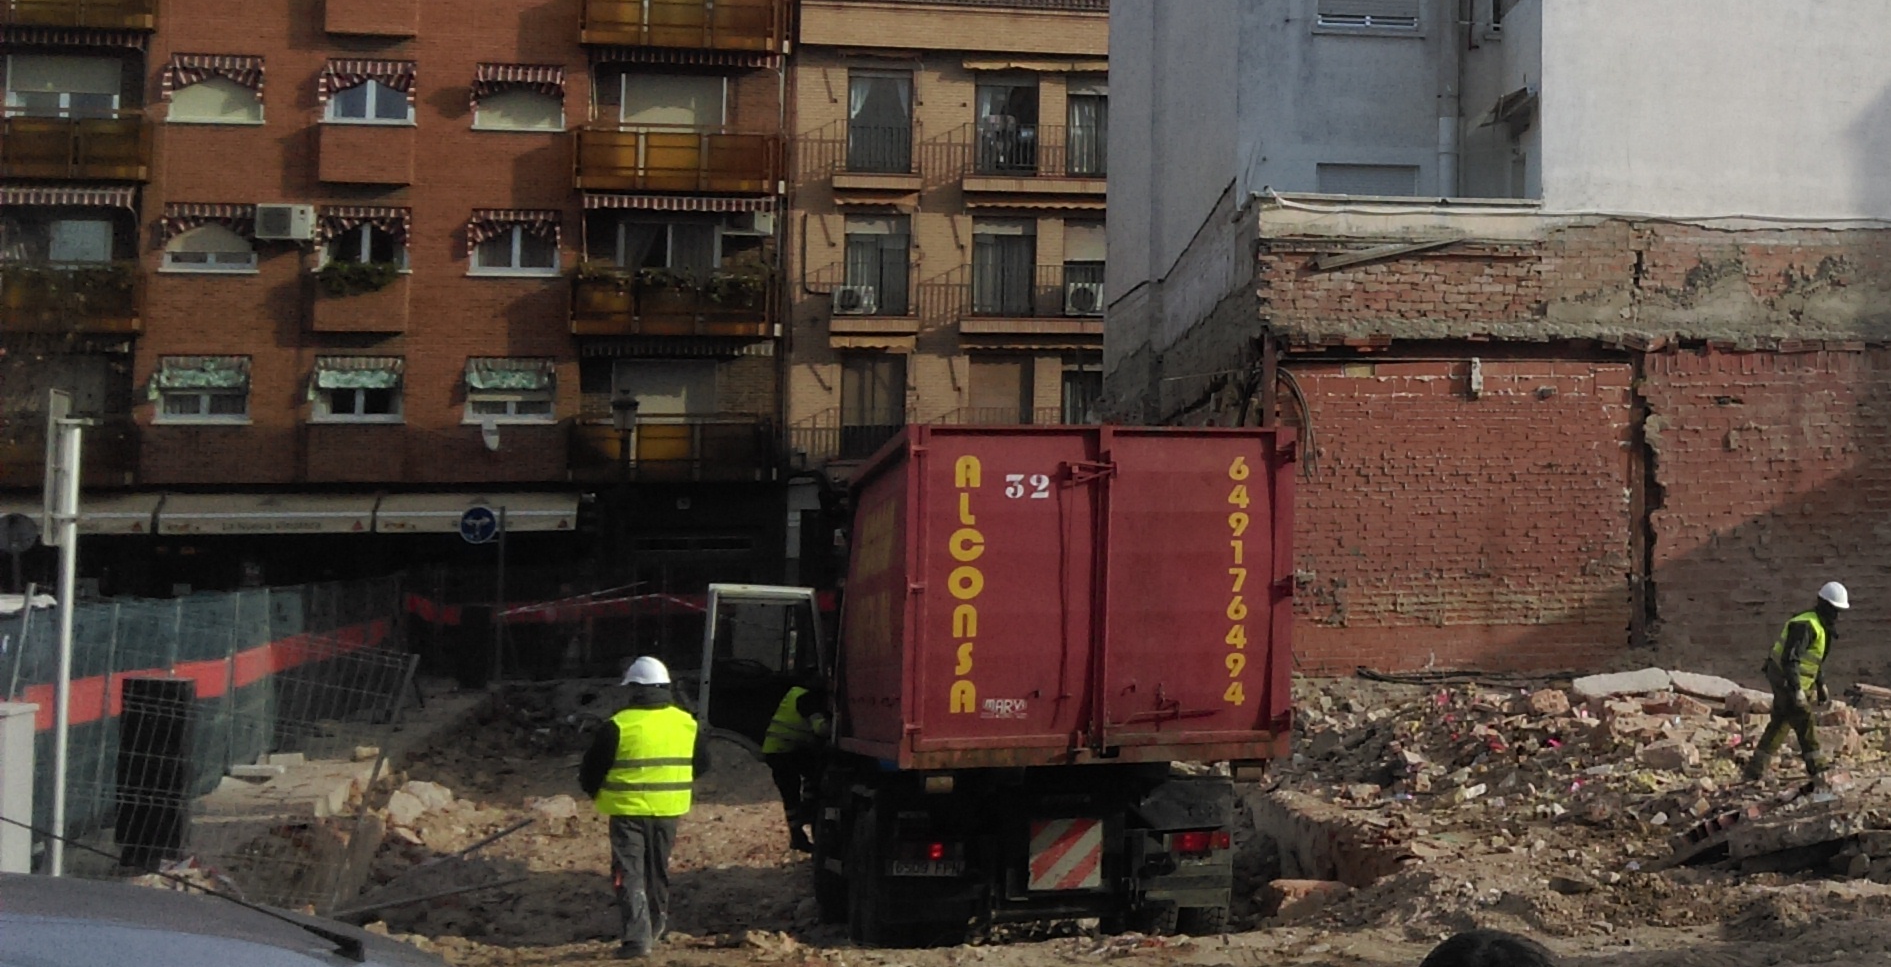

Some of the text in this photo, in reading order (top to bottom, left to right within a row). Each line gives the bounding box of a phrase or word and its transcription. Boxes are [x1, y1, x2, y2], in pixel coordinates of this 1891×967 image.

[947, 454, 985, 714] ALCONSA
[1004, 473, 1050, 499] 32
[1223, 456, 1249, 707] 649176494
